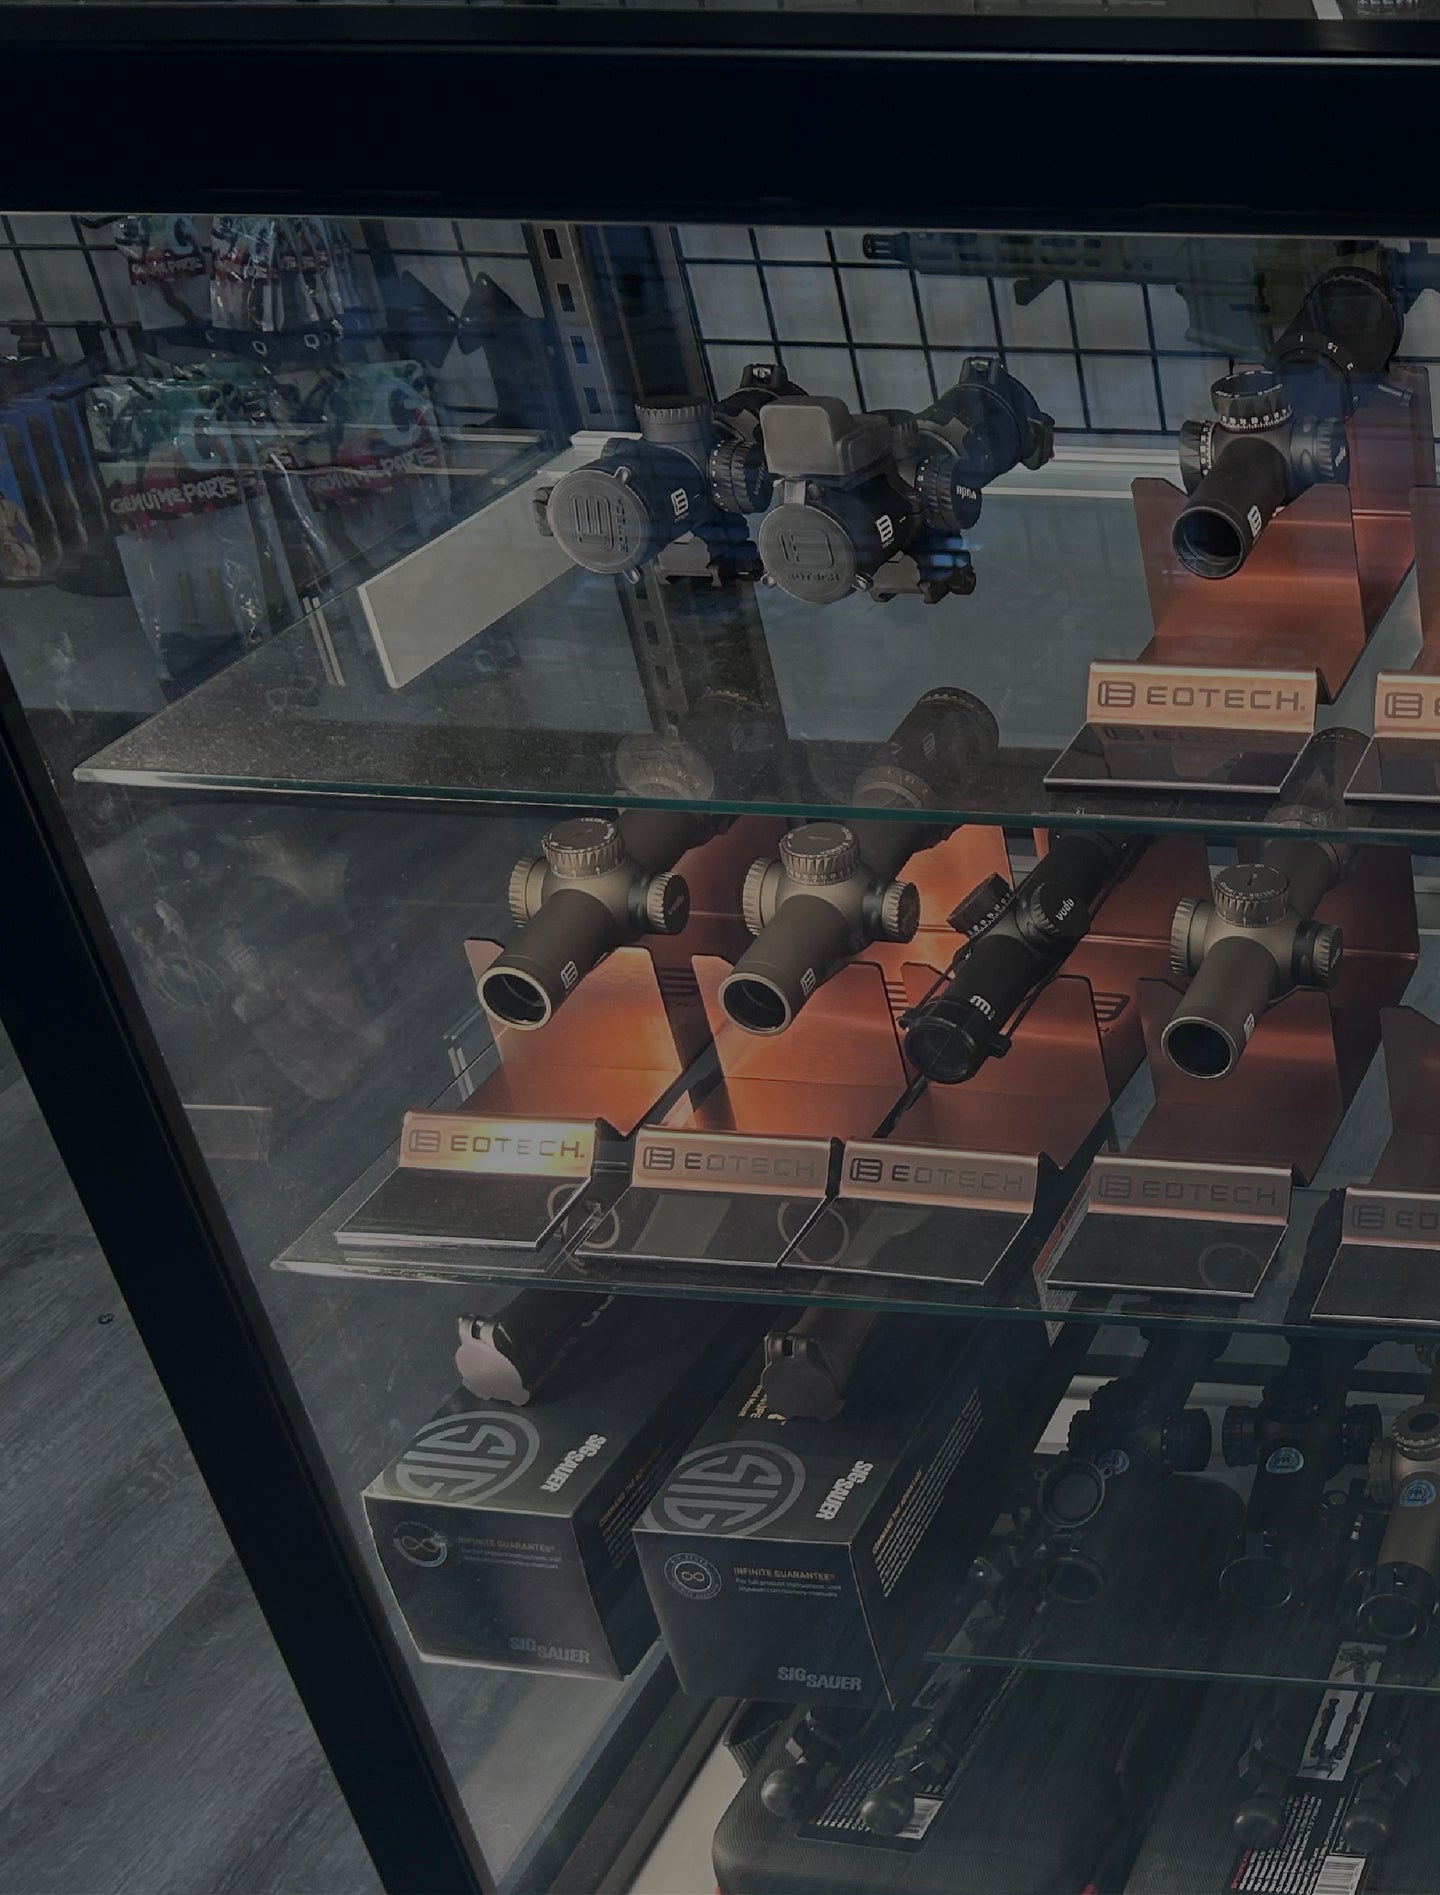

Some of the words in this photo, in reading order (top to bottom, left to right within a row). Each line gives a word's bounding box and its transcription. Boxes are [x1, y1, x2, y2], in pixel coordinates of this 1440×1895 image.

[183, 475, 238, 502] PARTS
[1147, 686, 1301, 712] EOTECH
[684, 1152, 818, 1179] EOTECH
[892, 1165, 1023, 1191] EOTECH
[1142, 1179, 1277, 1205] EOTECH
[585, 1433, 608, 1458] SIG
[540, 1449, 586, 1493] SAUER
[849, 1460, 875, 1484] SIG
[815, 1477, 855, 1520] SAUER
[733, 1567, 773, 1578] INFINITE
[509, 1637, 537, 1652] SIG
[537, 1645, 590, 1664] SAUER
[777, 1666, 806, 1682] SIG
[806, 1673, 862, 1691] SAUER
